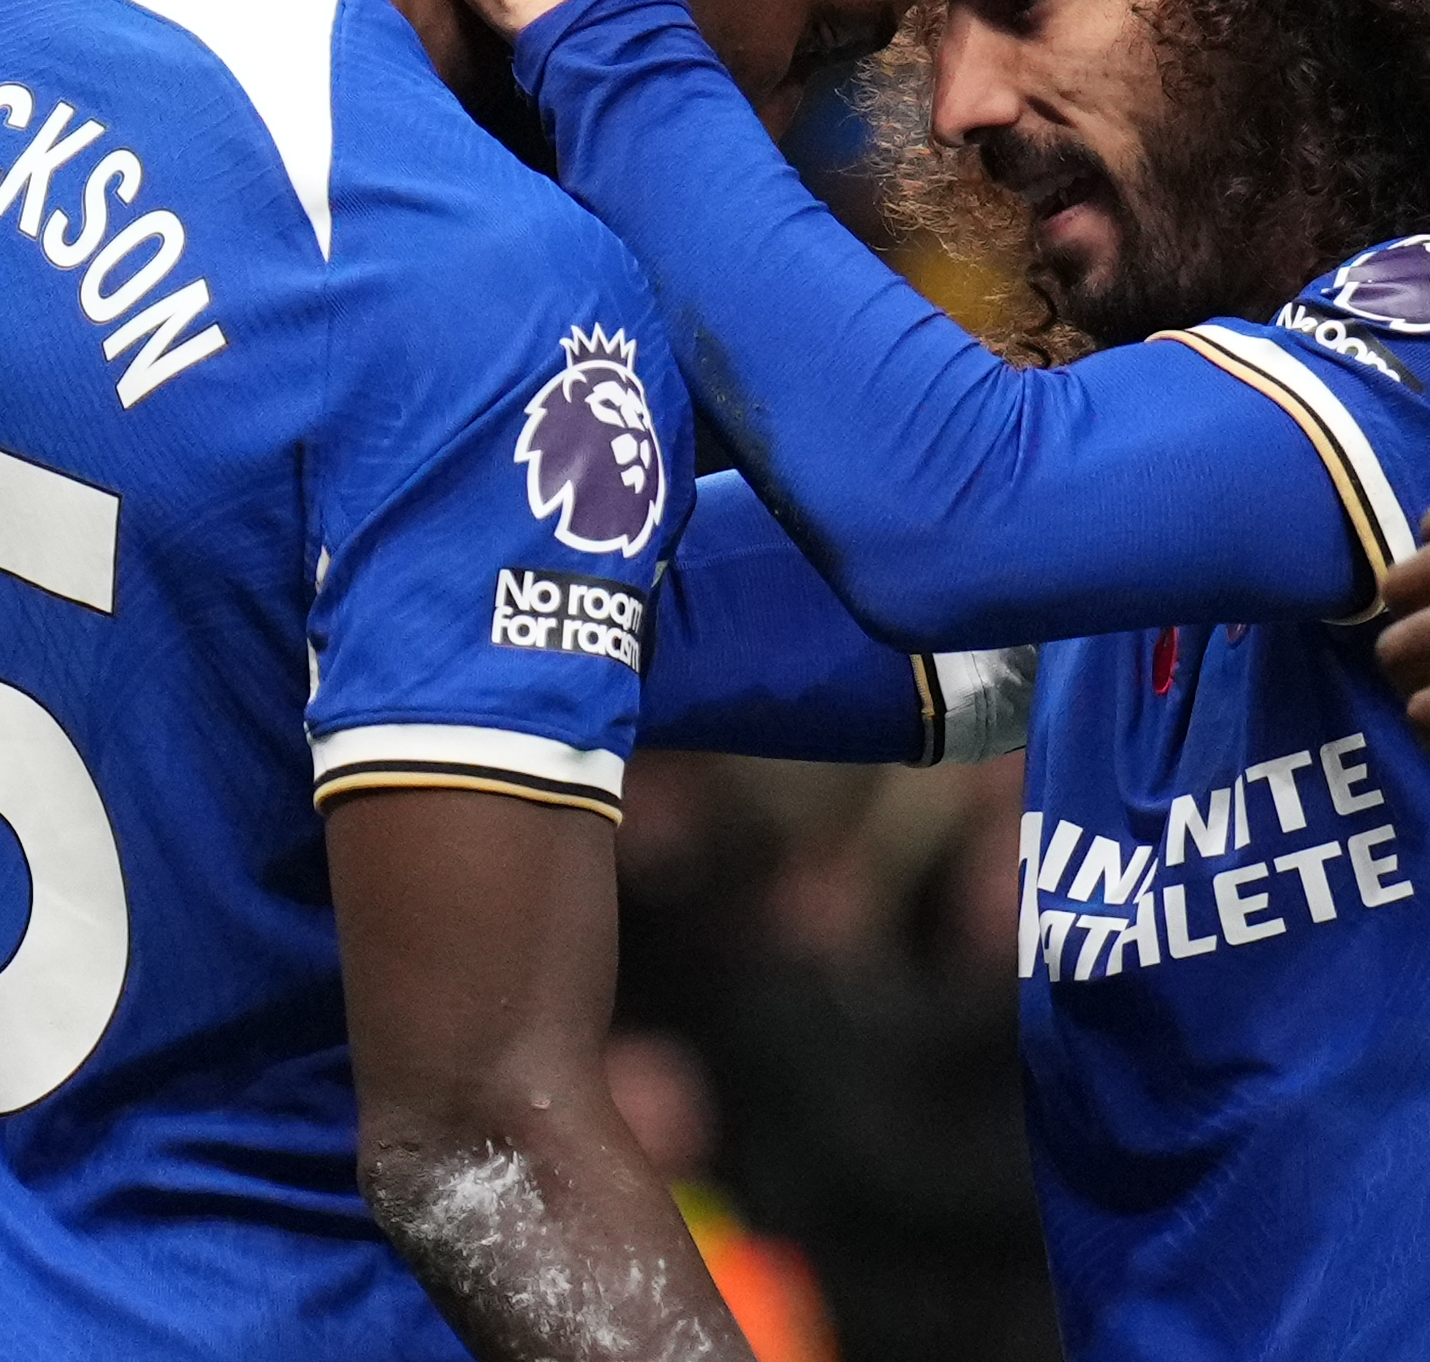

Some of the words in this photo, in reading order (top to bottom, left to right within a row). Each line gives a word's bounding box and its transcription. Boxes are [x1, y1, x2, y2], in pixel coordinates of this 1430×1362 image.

[491, 604, 557, 648] for
[495, 568, 560, 613] No
[568, 584, 643, 634] room
[1039, 823, 1415, 983] ATHLETE
